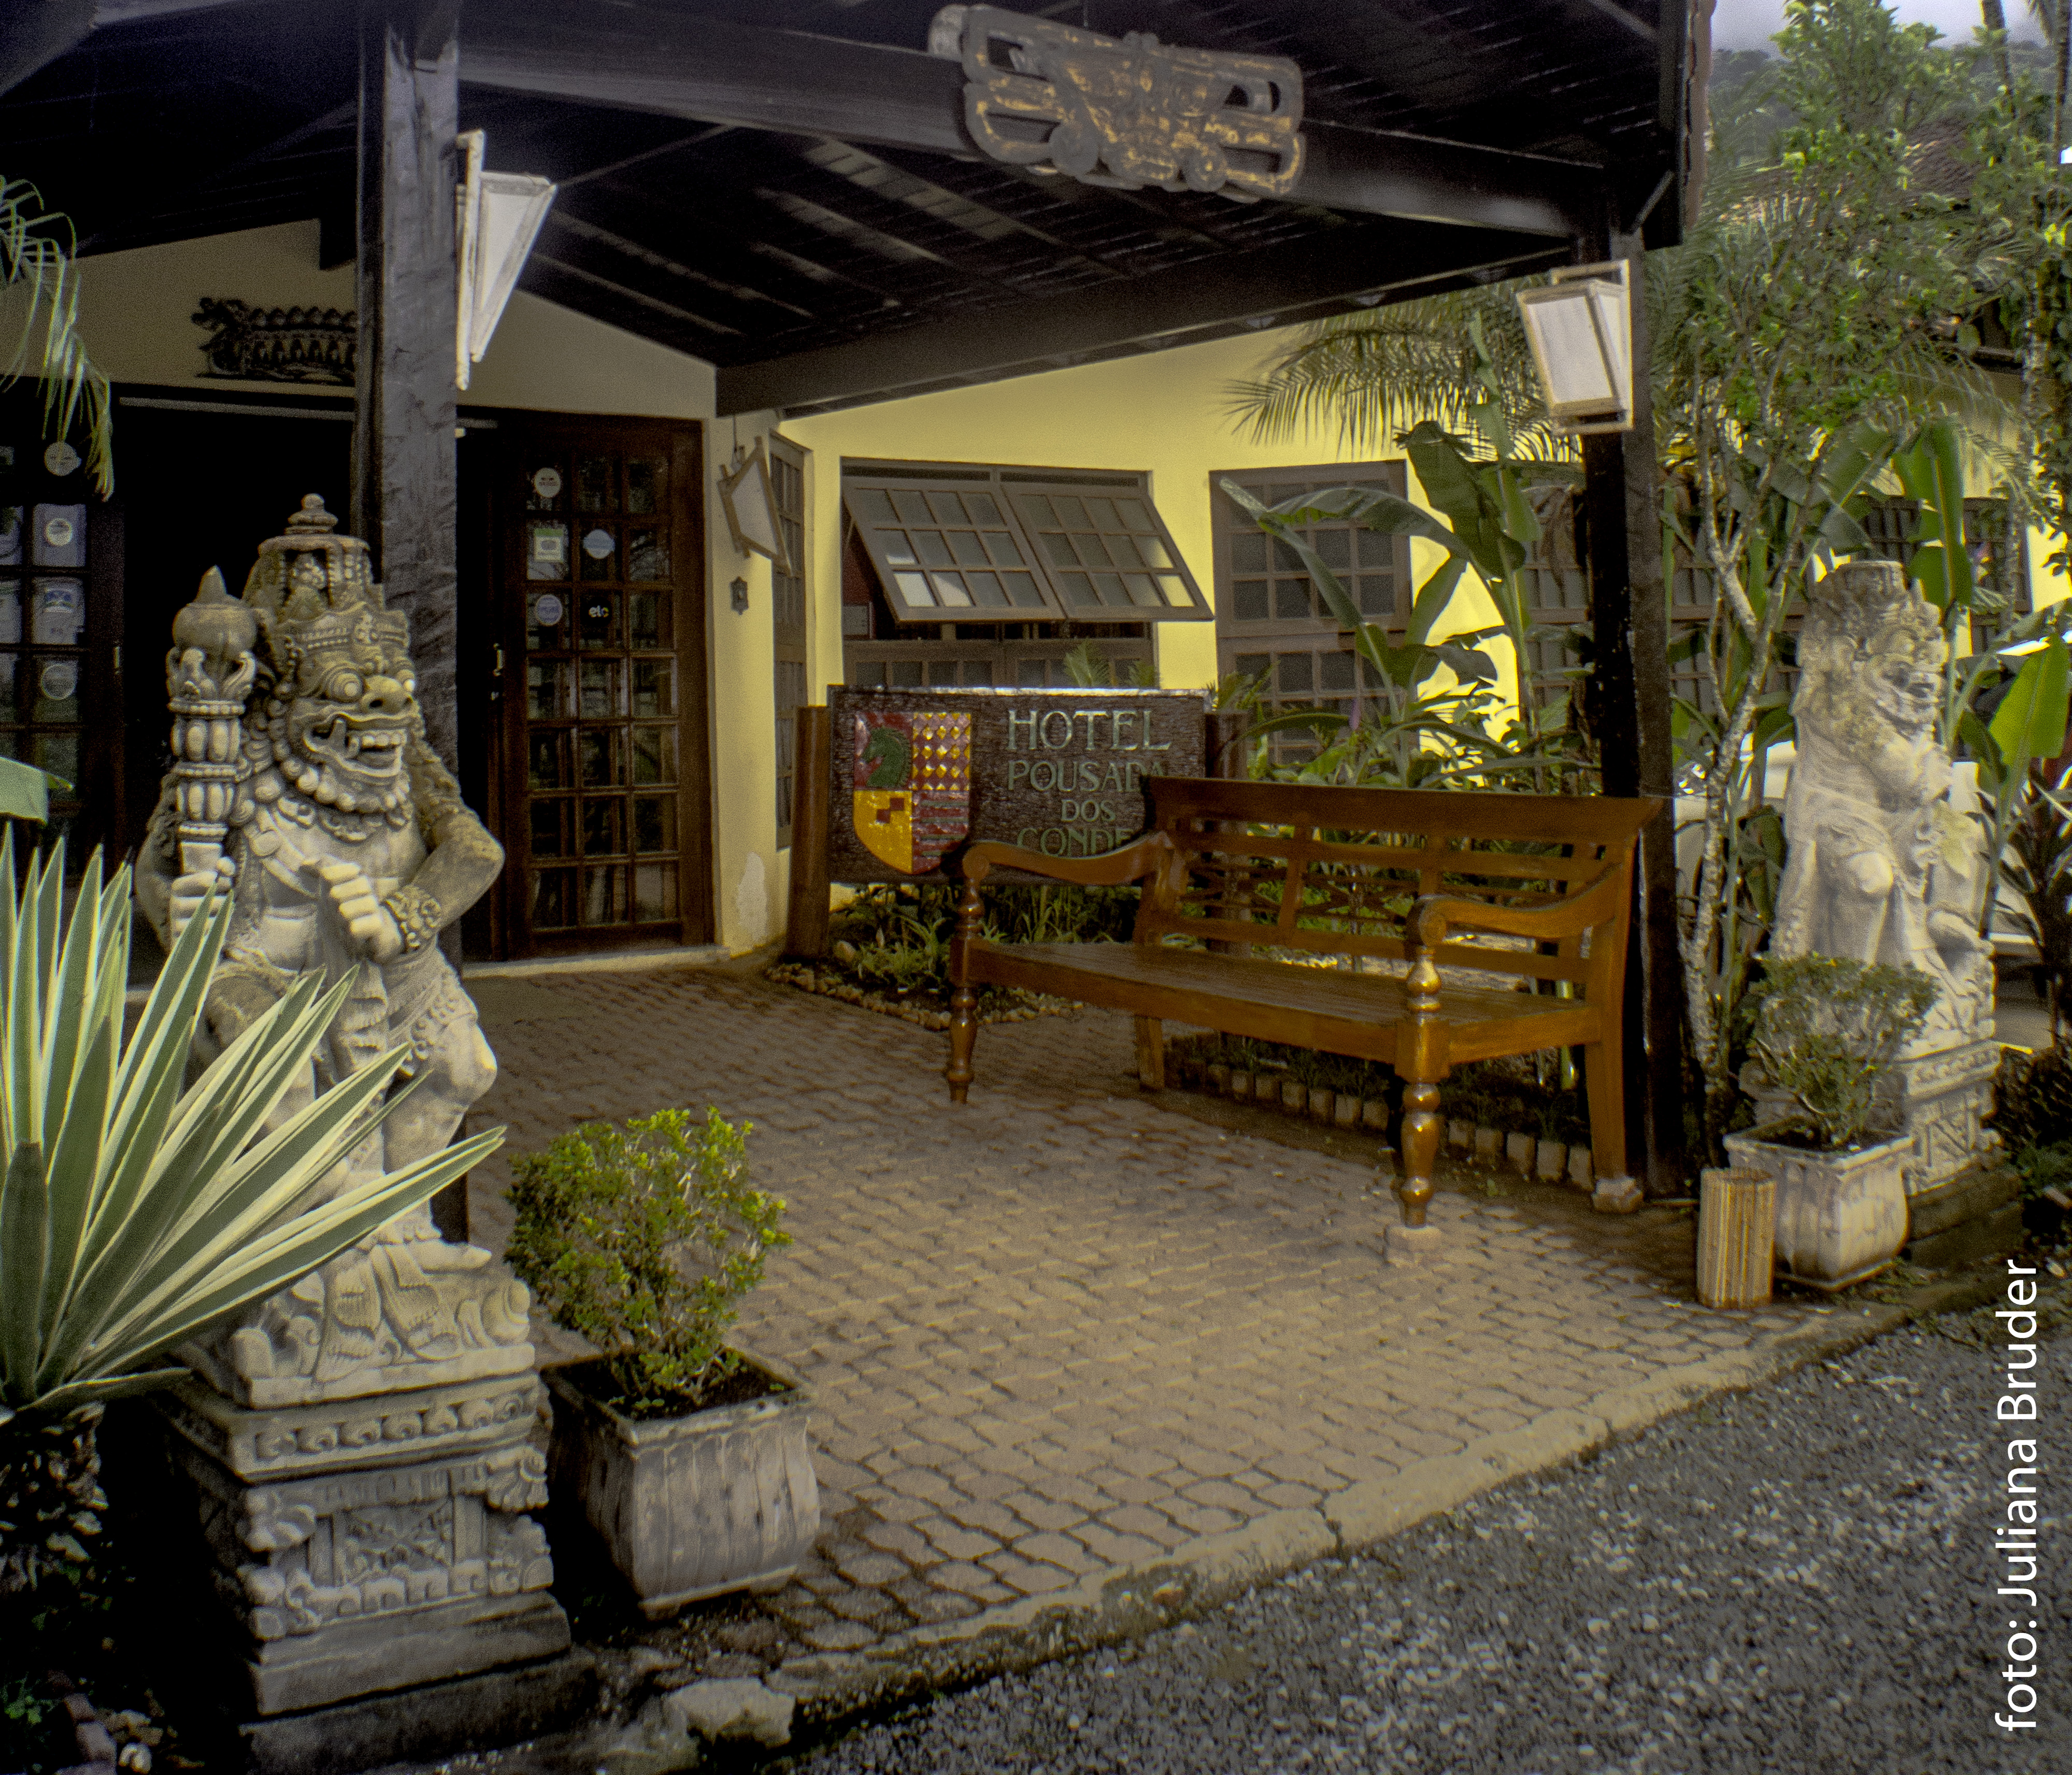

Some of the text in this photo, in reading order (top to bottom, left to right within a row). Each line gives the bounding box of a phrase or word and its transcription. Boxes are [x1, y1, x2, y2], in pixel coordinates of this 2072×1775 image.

[1007, 709, 1172, 750] HOTEL
[1061, 799, 1115, 822] DOS
[1017, 827, 1134, 857] CONDE
